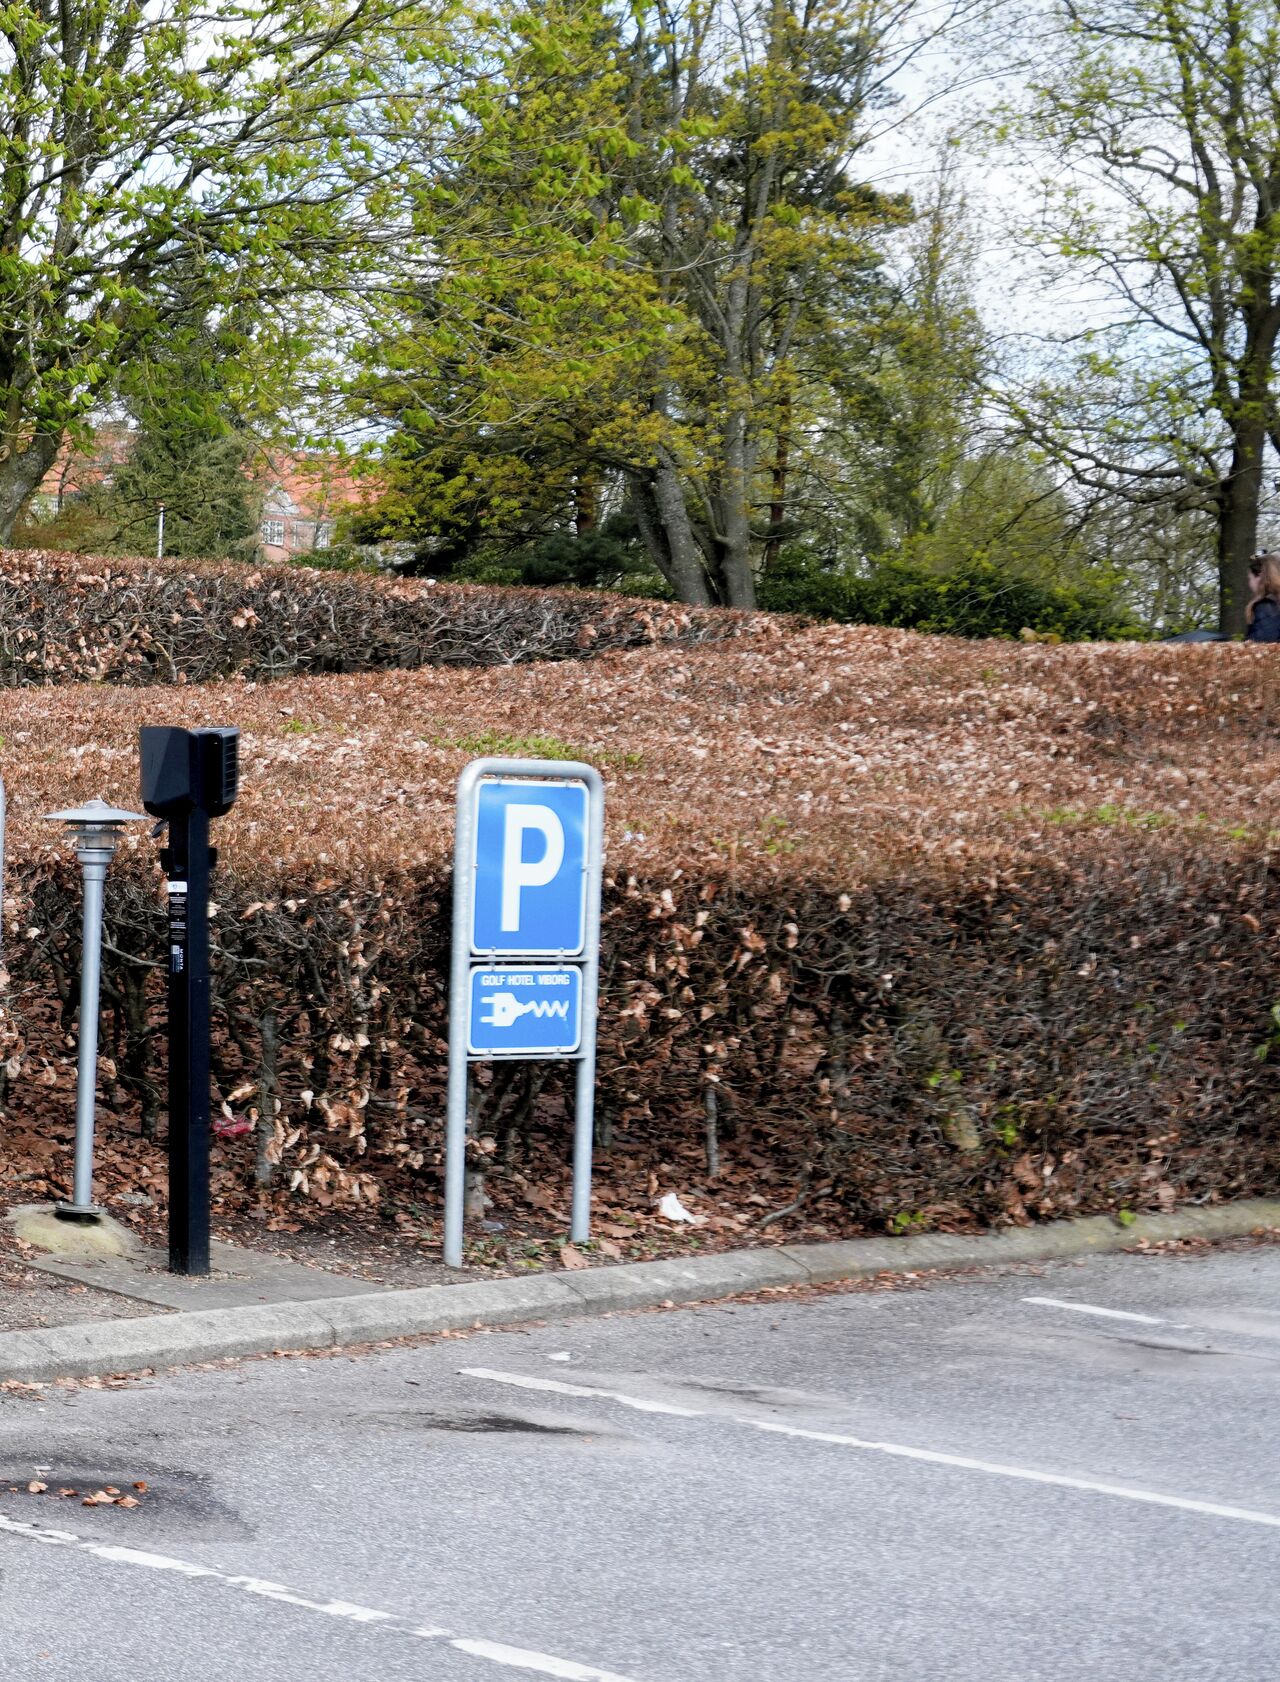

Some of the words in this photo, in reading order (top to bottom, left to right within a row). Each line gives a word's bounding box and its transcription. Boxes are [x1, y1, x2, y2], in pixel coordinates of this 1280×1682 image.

[500, 803, 565, 932] P
[481, 974, 506, 986] GOLF
[507, 974, 536, 986] HOTEL
[538, 974, 570, 985] VIBORG
